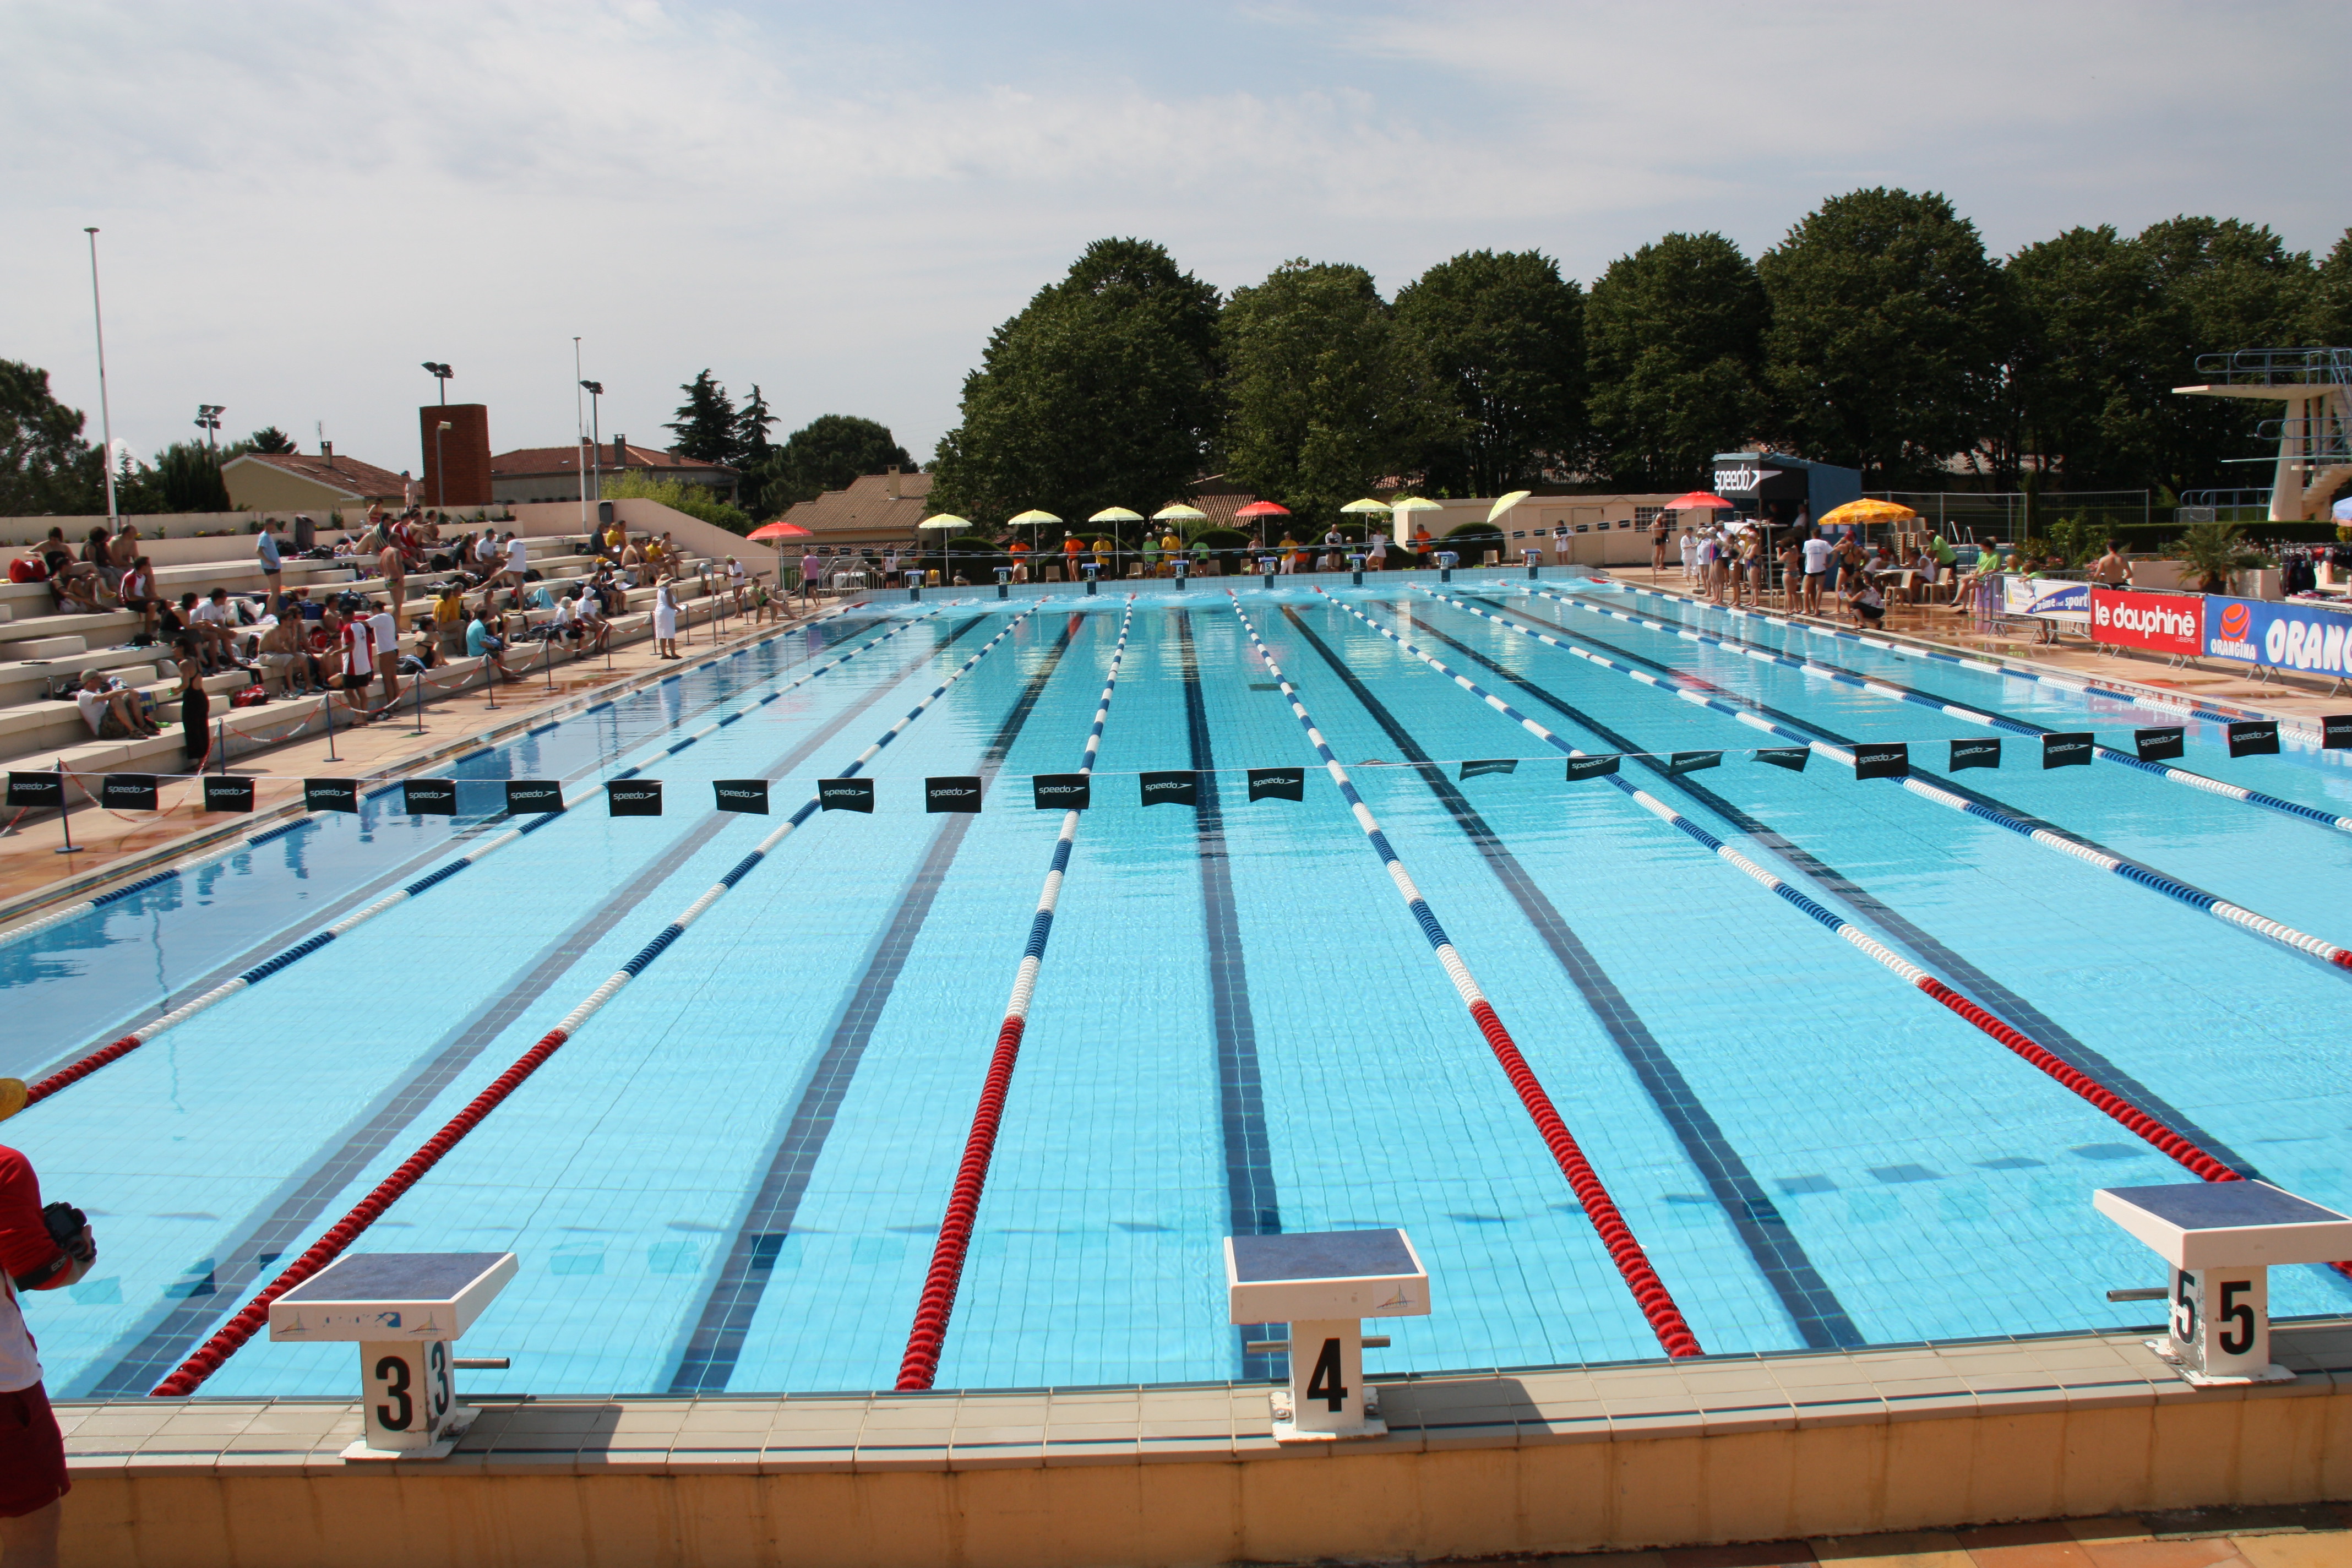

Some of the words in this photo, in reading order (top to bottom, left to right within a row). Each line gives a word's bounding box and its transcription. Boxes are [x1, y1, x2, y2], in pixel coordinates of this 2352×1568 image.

[1714, 464, 1749, 496] speedo
[1000, 572, 1005, 580] 2
[2065, 593, 2088, 610] sport
[2095, 599, 2110, 627] le
[2113, 602, 2196, 639] dauphiné
[2326, 724, 2352, 734] speedo
[2140, 736, 2168, 747] speedo
[2233, 731, 2261, 742] speedo
[1954, 746, 1982, 758] speedo
[2047, 743, 2074, 754] speedo
[1571, 758, 1603, 770] speedo
[1859, 753, 1888, 764] speedo
[12, 782, 42, 792] speedo
[1145, 781, 1178, 791] speedo
[1253, 777, 1284, 787] speedo
[108, 784, 140, 794] speedo
[209, 787, 239, 797] speedo
[310, 788, 339, 797] speedo
[719, 789, 750, 798] speedo
[824, 788, 856, 797] speedo
[930, 787, 962, 798] speedo
[1038, 785, 1071, 794] speedo
[409, 791, 438, 800] speedo
[511, 790, 543, 801] speedo
[613, 791, 644, 801] speedo
[2175, 1269, 2196, 1344] 5
[2219, 1280, 2255, 1355] 5
[431, 1341, 450, 1416] 3
[1307, 1337, 1348, 1412] 4
[375, 1355, 413, 1431] 3
